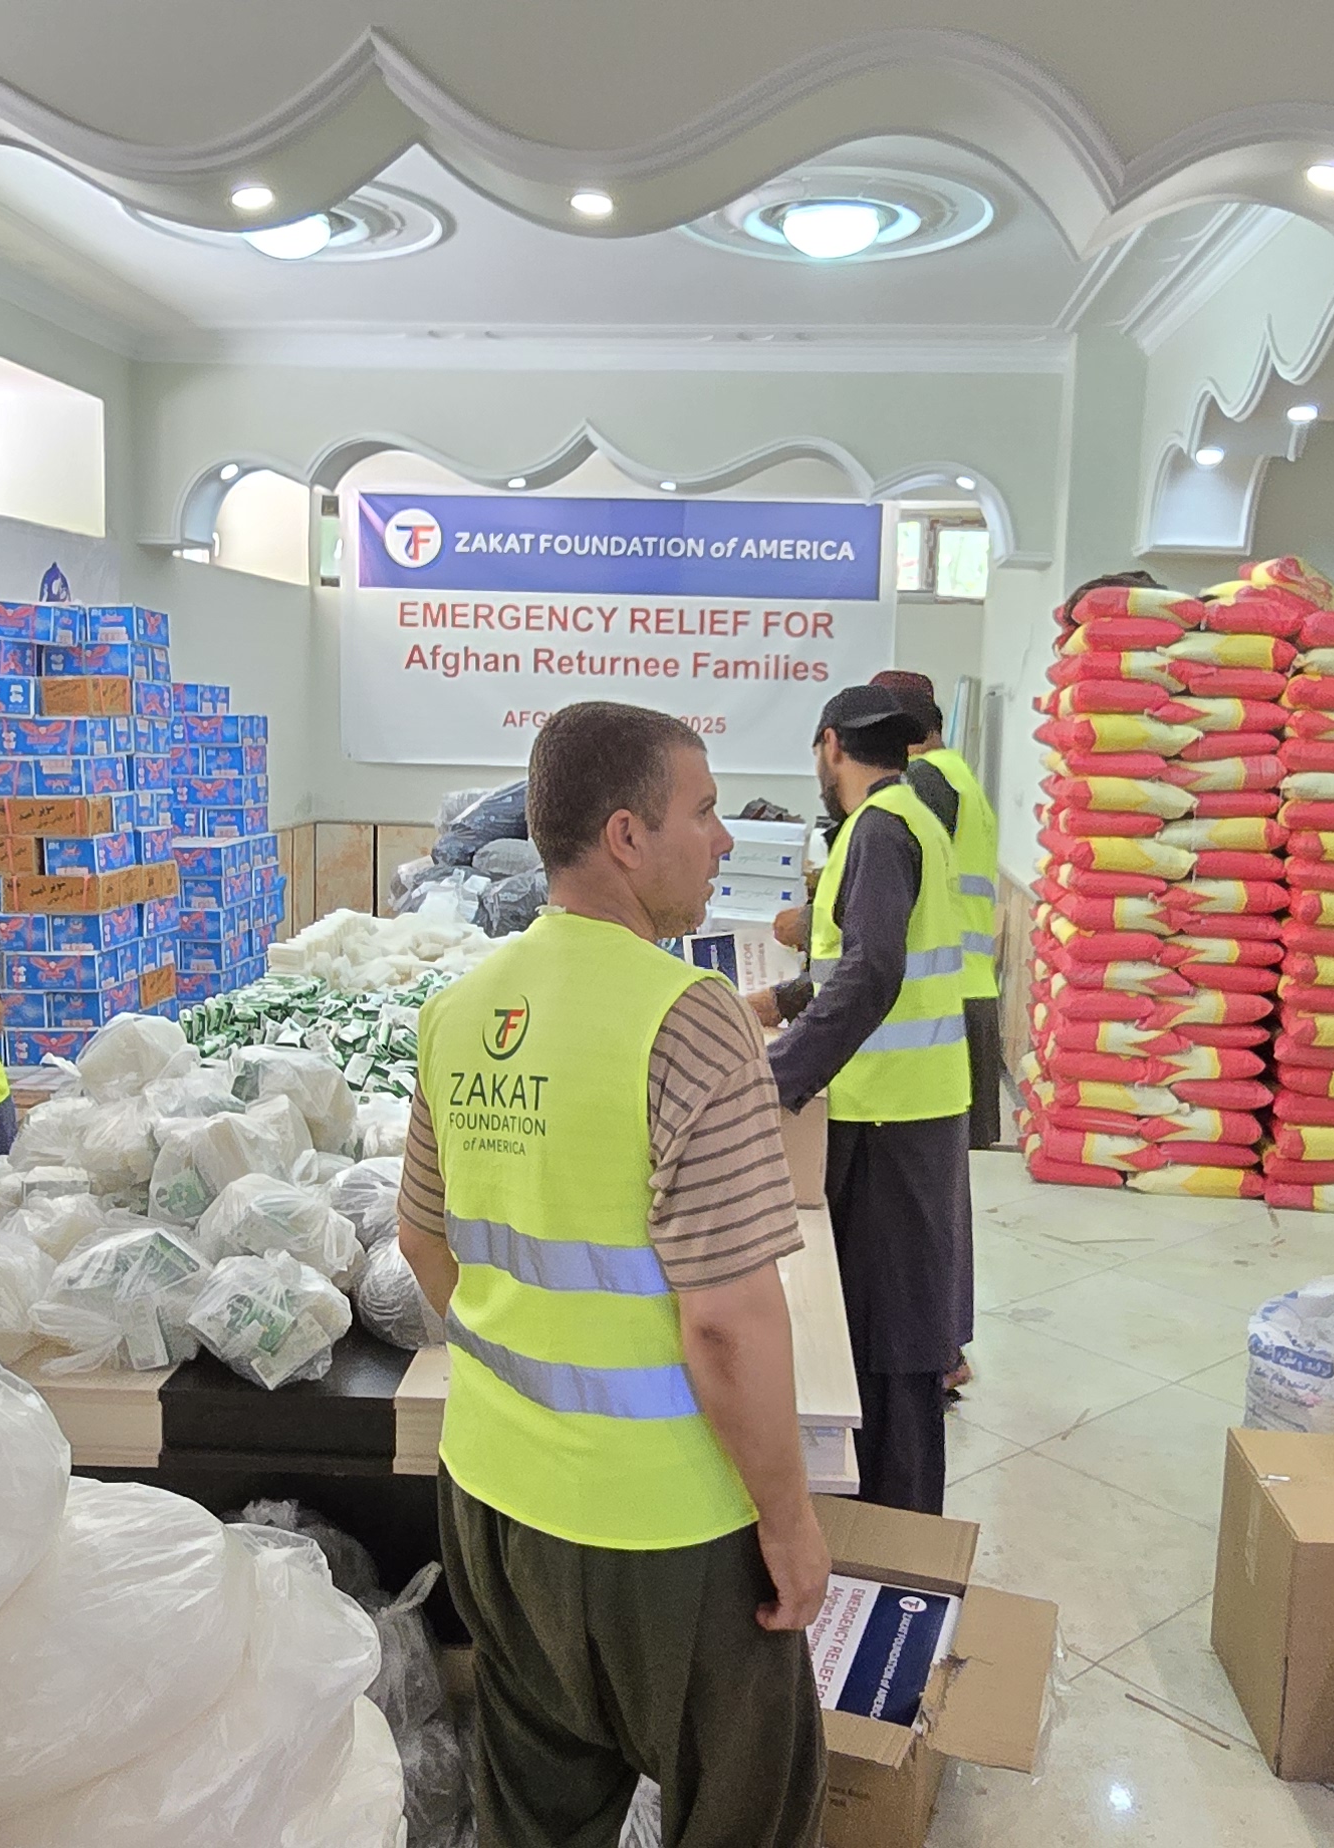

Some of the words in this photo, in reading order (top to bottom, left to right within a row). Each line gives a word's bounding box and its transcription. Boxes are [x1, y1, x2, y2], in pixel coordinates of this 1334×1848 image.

[455, 532, 535, 554] ZAKAT
[539, 534, 705, 558] FOUNDATION
[710, 537, 738, 558] of
[740, 538, 855, 561] AMERICA
[399, 601, 619, 633] EMERGENCY
[629, 607, 751, 637] RELIEF
[763, 611, 835, 639] FOR
[404, 643, 521, 678] Afghan
[533, 648, 680, 678] Returnee
[692, 652, 829, 682] Families
[449, 1072, 549, 1111] ZAKAT
[449, 1112, 546, 1137] FOUNDATION
[463, 1137, 476, 1151] of
[478, 1139, 526, 1156] AMERICA
[833, 1587, 866, 1646] EMERGENCY
[819, 1643, 844, 1683] RELIEF
[870, 1687, 888, 1719] AMERIC
